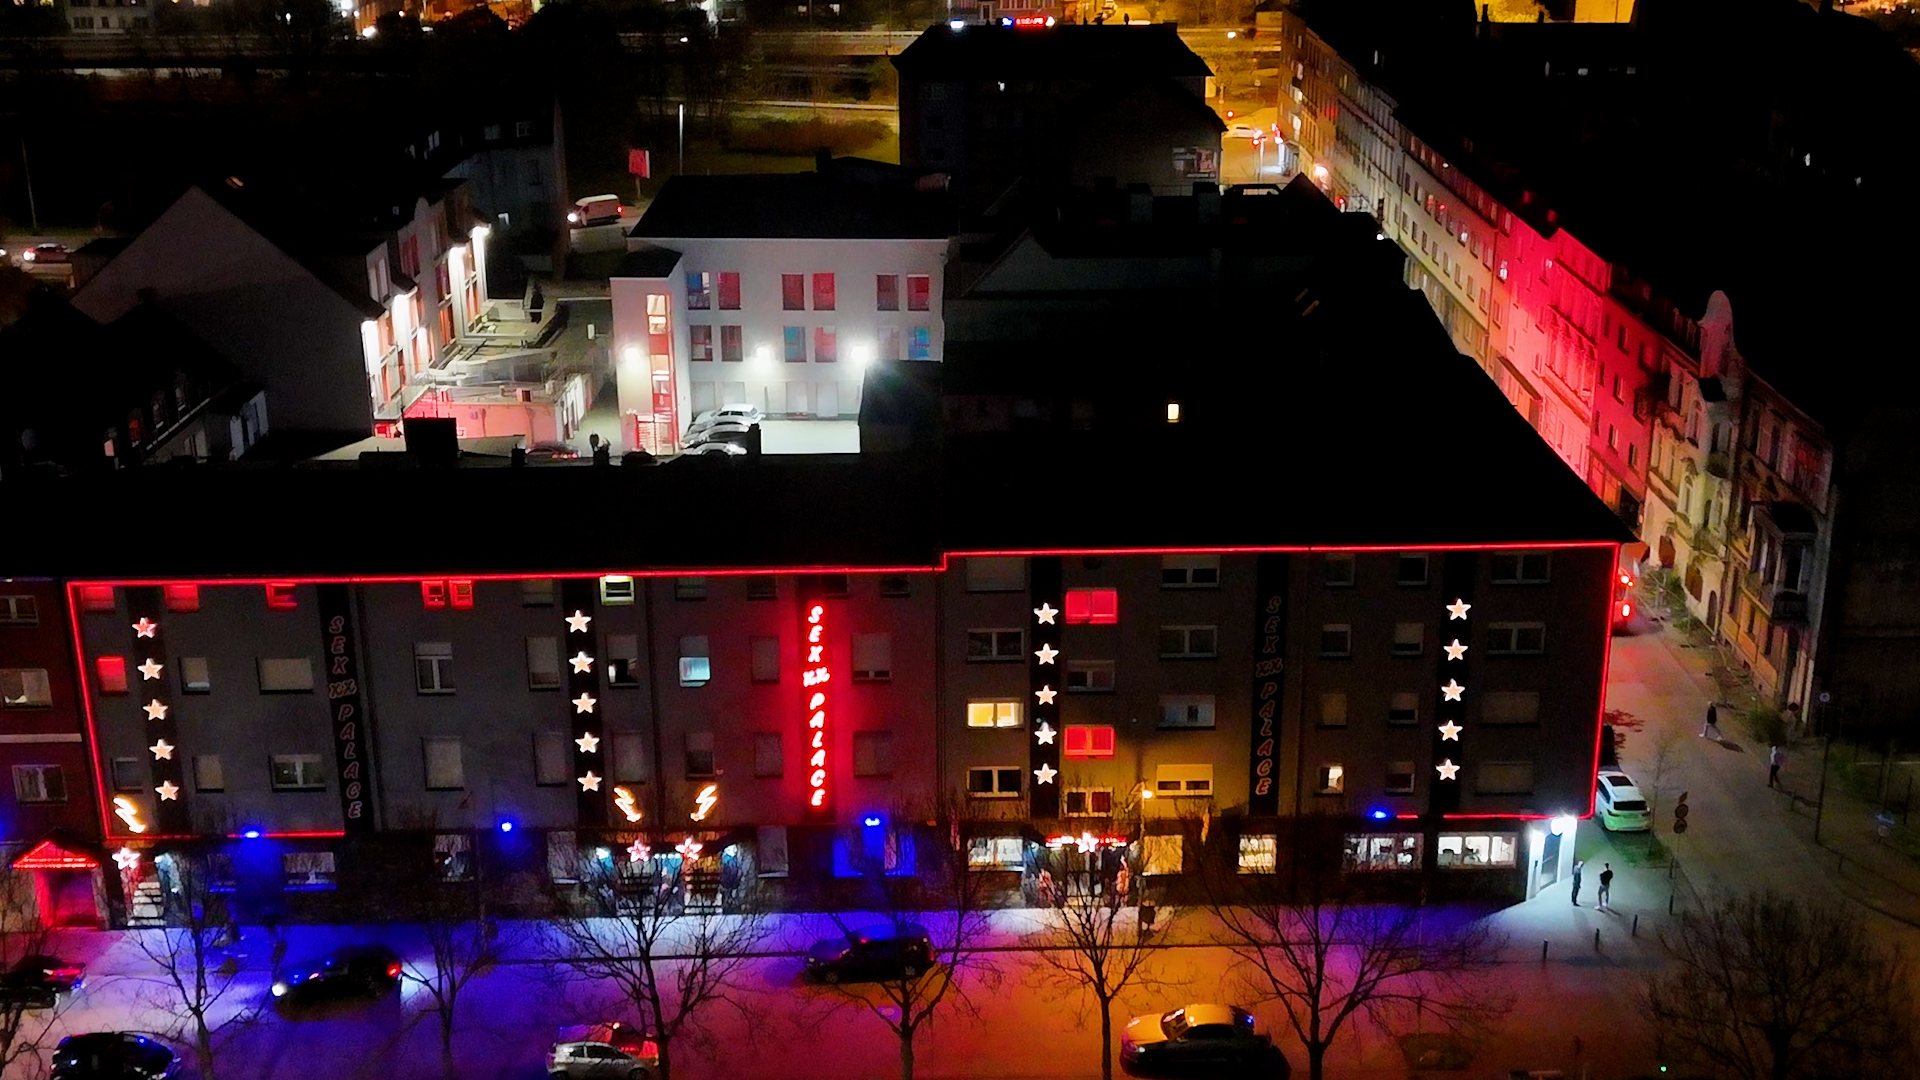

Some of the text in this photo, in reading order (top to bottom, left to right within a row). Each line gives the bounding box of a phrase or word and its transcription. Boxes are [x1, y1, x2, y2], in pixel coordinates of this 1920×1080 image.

[329, 616, 348, 675] SEX
[808, 605, 824, 662] SEX
[1263, 597, 1282, 653] SEX
[338, 704, 362, 819] PALACE
[809, 692, 826, 807] PALACE
[1256, 683, 1276, 795] PALACE
